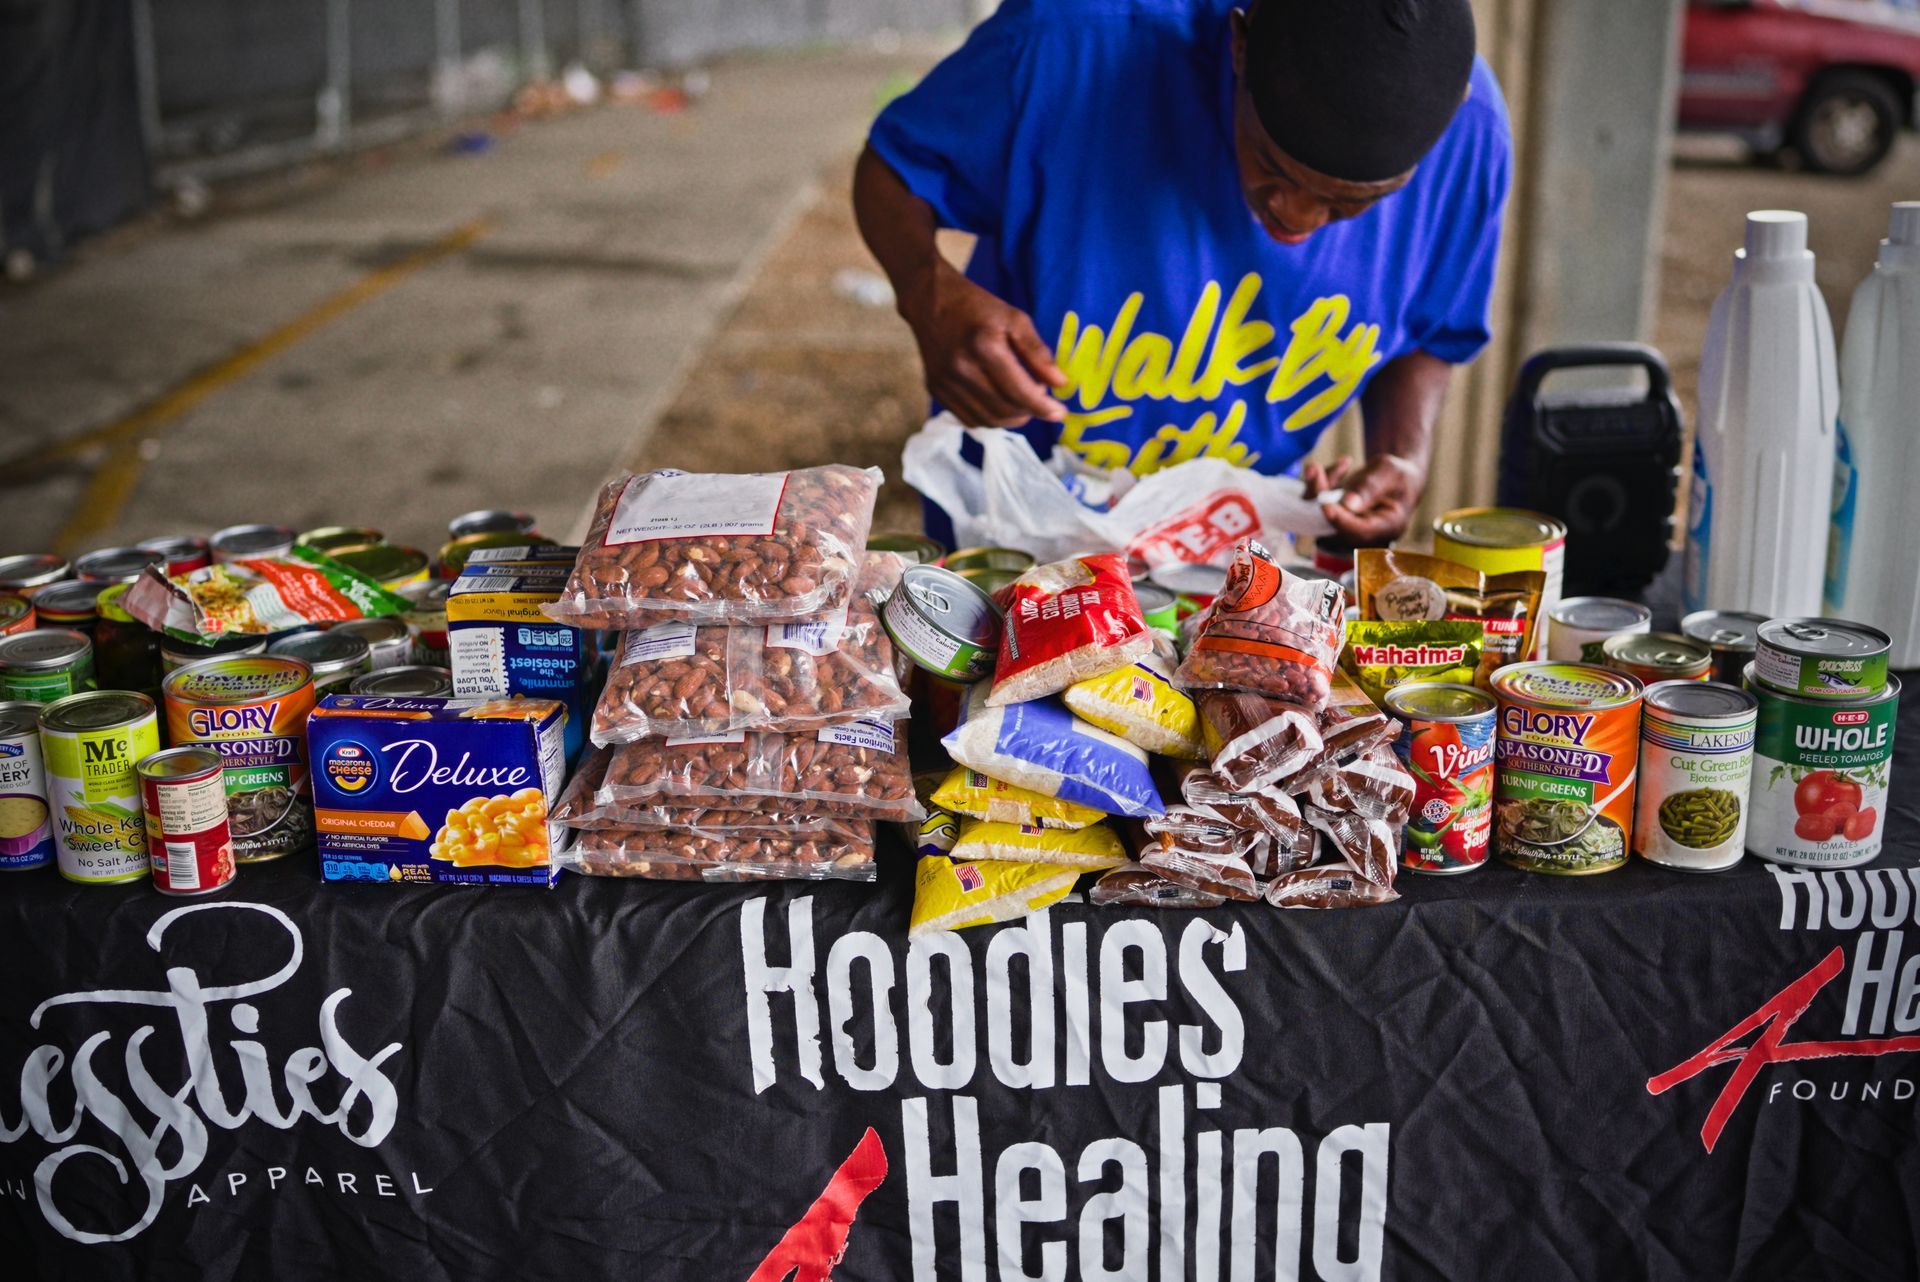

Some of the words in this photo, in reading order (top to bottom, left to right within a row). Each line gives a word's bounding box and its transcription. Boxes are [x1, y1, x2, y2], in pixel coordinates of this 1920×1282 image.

[1052, 272, 1280, 409] Walk
[1266, 295, 1381, 431] By
[483, 608, 506, 617] flavor
[507, 607, 541, 617] original
[1355, 644, 1464, 667] Mahatma
[510, 657, 576, 673] cheesiest
[479, 676, 495, 685] You
[540, 669, 554, 678] the
[456, 676, 477, 686] Love
[457, 685, 482, 695] Taste
[483, 684, 500, 693] The
[363, 697, 439, 710] Deluxe
[188, 702, 280, 738] GLORY
[1503, 706, 1596, 747] GLORY
[834, 733, 857, 744] Facts
[858, 737, 893, 752] Nutrition
[1525, 734, 1567, 745] FOODS
[1796, 723, 1889, 752] WHOLE
[190, 738, 292, 757] ASONED
[222, 757, 247, 768] HERN
[248, 755, 275, 767] STYLE
[328, 759, 365, 767] macaroni
[1430, 743, 1489, 780] Vine
[1497, 740, 1602, 774] SEASONED
[1671, 756, 1696, 772] Cut
[1700, 759, 1738, 772] Green
[1800, 752, 1838, 764] PEELED
[1841, 750, 1884, 763] TOMATOES
[13, 759, 28, 770] OF
[86, 759, 131, 777] TRADER
[381, 739, 531, 794] Deluxe
[1507, 758, 1551, 774] SOUTHERN
[1551, 764, 1581, 778] STYLE
[0, 768, 31, 783] ERY
[238, 771, 284, 785] GREENS
[1689, 773, 1717, 783] Ejotes
[1501, 774, 1538, 791] TURNIP
[1540, 781, 1588, 799] GREENS
[59, 816, 113, 835] Whole
[183, 824, 192, 832] 35
[321, 817, 358, 827] ORIGINAL
[359, 819, 396, 829] CHEDDAR
[68, 836, 121, 852] Sweet
[232, 840, 262, 851] outhern
[1816, 841, 1858, 850] TOMATES
[78, 858, 95, 868] No
[97, 856, 121, 867] Salt
[125, 851, 148, 864] Add
[1518, 846, 1552, 860] Southern
[1776, 847, 1787, 856] NET
[1788, 849, 1798, 858] WT.
[1800, 851, 1807, 860] 28
[1808, 852, 1816, 860] OZ
[1832, 852, 1838, 860] 12
[325, 863, 338, 872] 310
[402, 868, 431, 876] REAL
[740, 896, 1247, 1096] Hoodies
[1769, 1079, 1916, 1104] FOUND
[187, 1166, 433, 1208] APPAREL
[901, 1083, 1391, 1282] Healing
